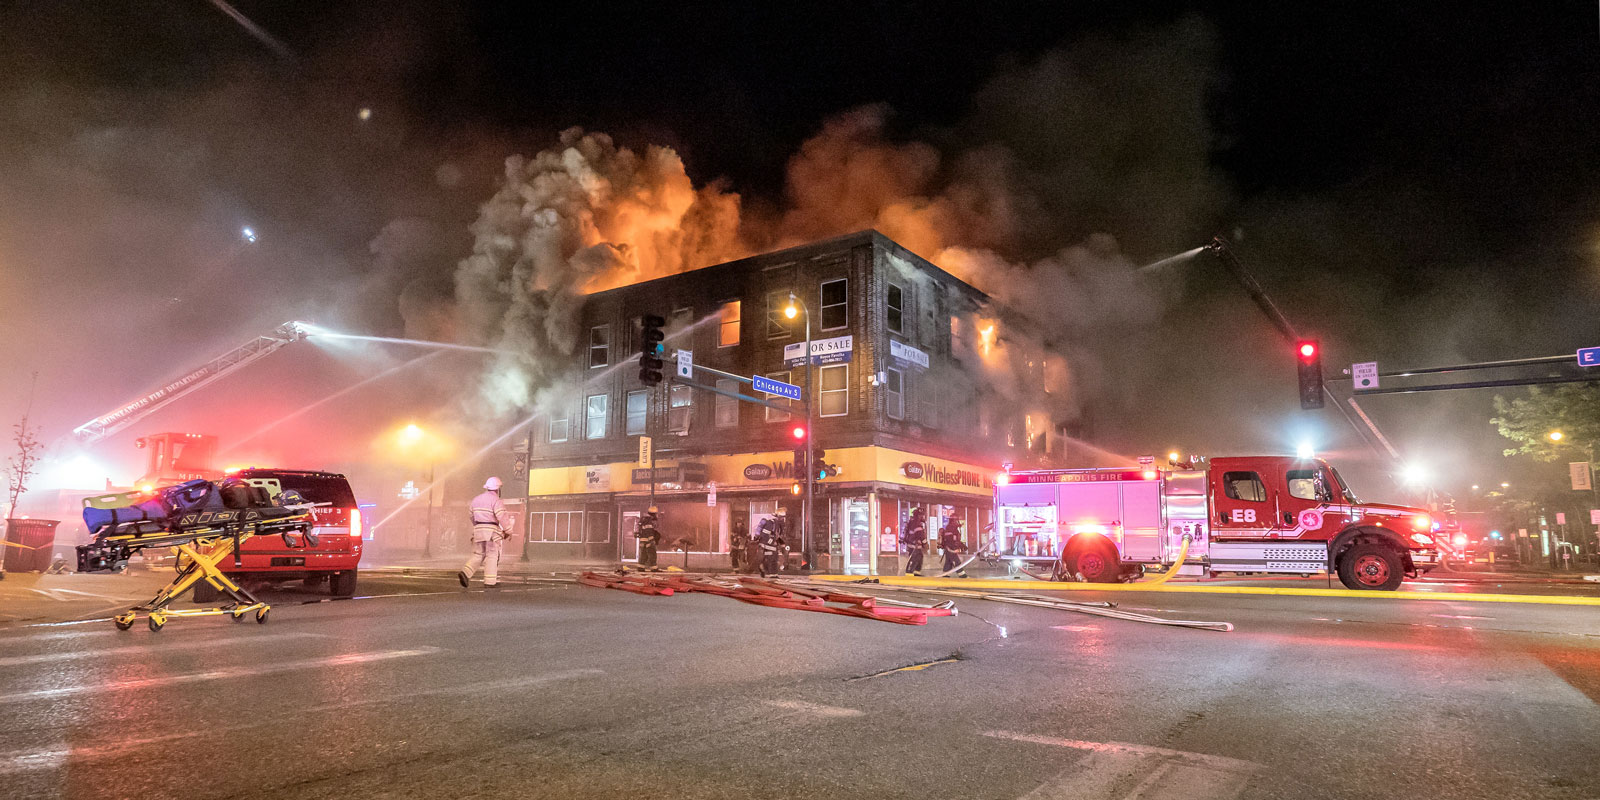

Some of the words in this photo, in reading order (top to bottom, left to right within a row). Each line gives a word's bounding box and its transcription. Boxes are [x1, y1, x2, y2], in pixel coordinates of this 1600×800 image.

[828, 340, 850, 350] SALE
[1584, 352, 1594, 362] E
[756, 380, 783, 393] Chicago
[784, 387, 792, 395] Av
[794, 389, 798, 397] S
[100, 398, 149, 426] MINNEAPOLIS
[149, 389, 166, 402] FIRE
[166, 366, 209, 393] DEPARTMENT
[745, 467, 768, 476] Galaxy
[908, 464, 923, 476] Galaxy
[1028, 474, 1097, 483] MINNEAPOLIS
[1100, 473, 1123, 481] FIRE
[1232, 508, 1257, 523] E8
